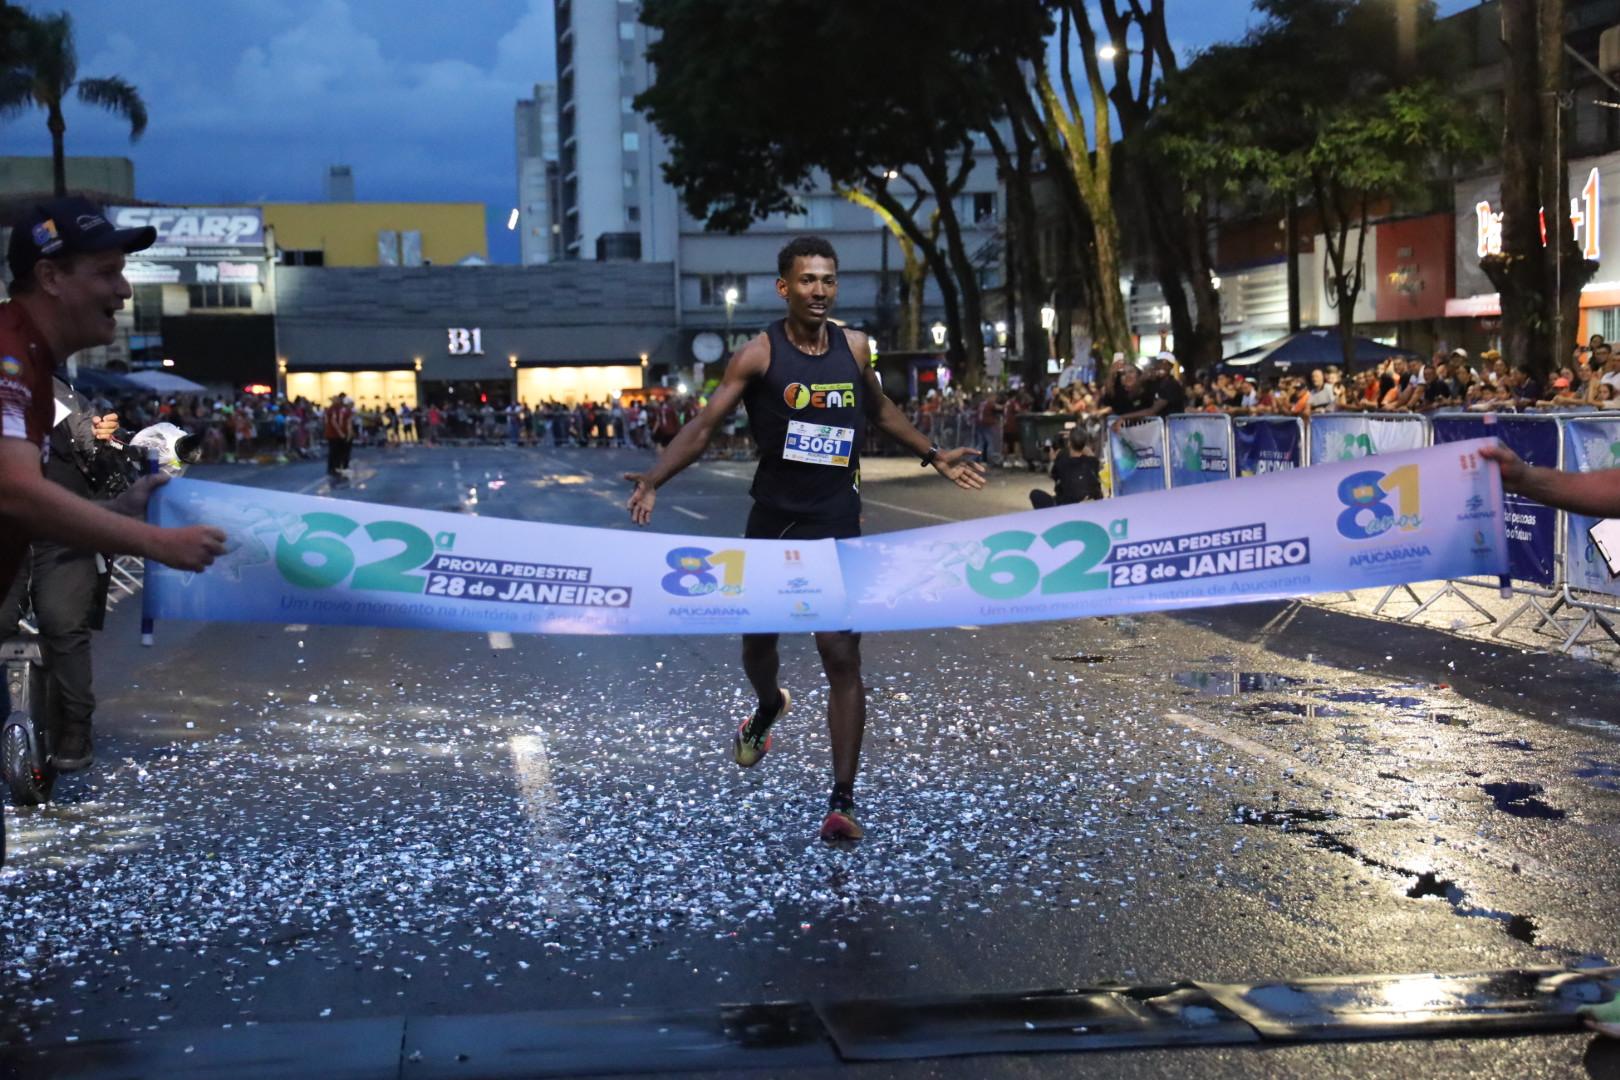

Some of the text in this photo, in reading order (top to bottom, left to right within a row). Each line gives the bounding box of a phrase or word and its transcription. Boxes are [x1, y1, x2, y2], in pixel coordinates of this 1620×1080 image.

[447, 327, 485, 356] B1
[798, 435, 842, 455] 5061
[1337, 464, 1421, 540] 81
[1115, 526, 1265, 561] PROVA PEDESTRE
[1349, 546, 1432, 567] APUCARANA
[436, 556, 589, 582] PROVA PEDESTRE
[661, 546, 746, 597] 81
[1114, 541, 1308, 587] 28 de JANEIRO
[429, 574, 631, 607] 28 de JANEIRO
[1149, 587, 1203, 604] história
[1207, 584, 1226, 595] de
[1230, 574, 1312, 595] Apucarana
[280, 596, 309, 611] Um
[321, 600, 353, 613] novo
[357, 602, 435, 617] momento
[438, 606, 457, 618] na
[461, 605, 518, 622] história
[669, 606, 751, 617] APUCARANA
